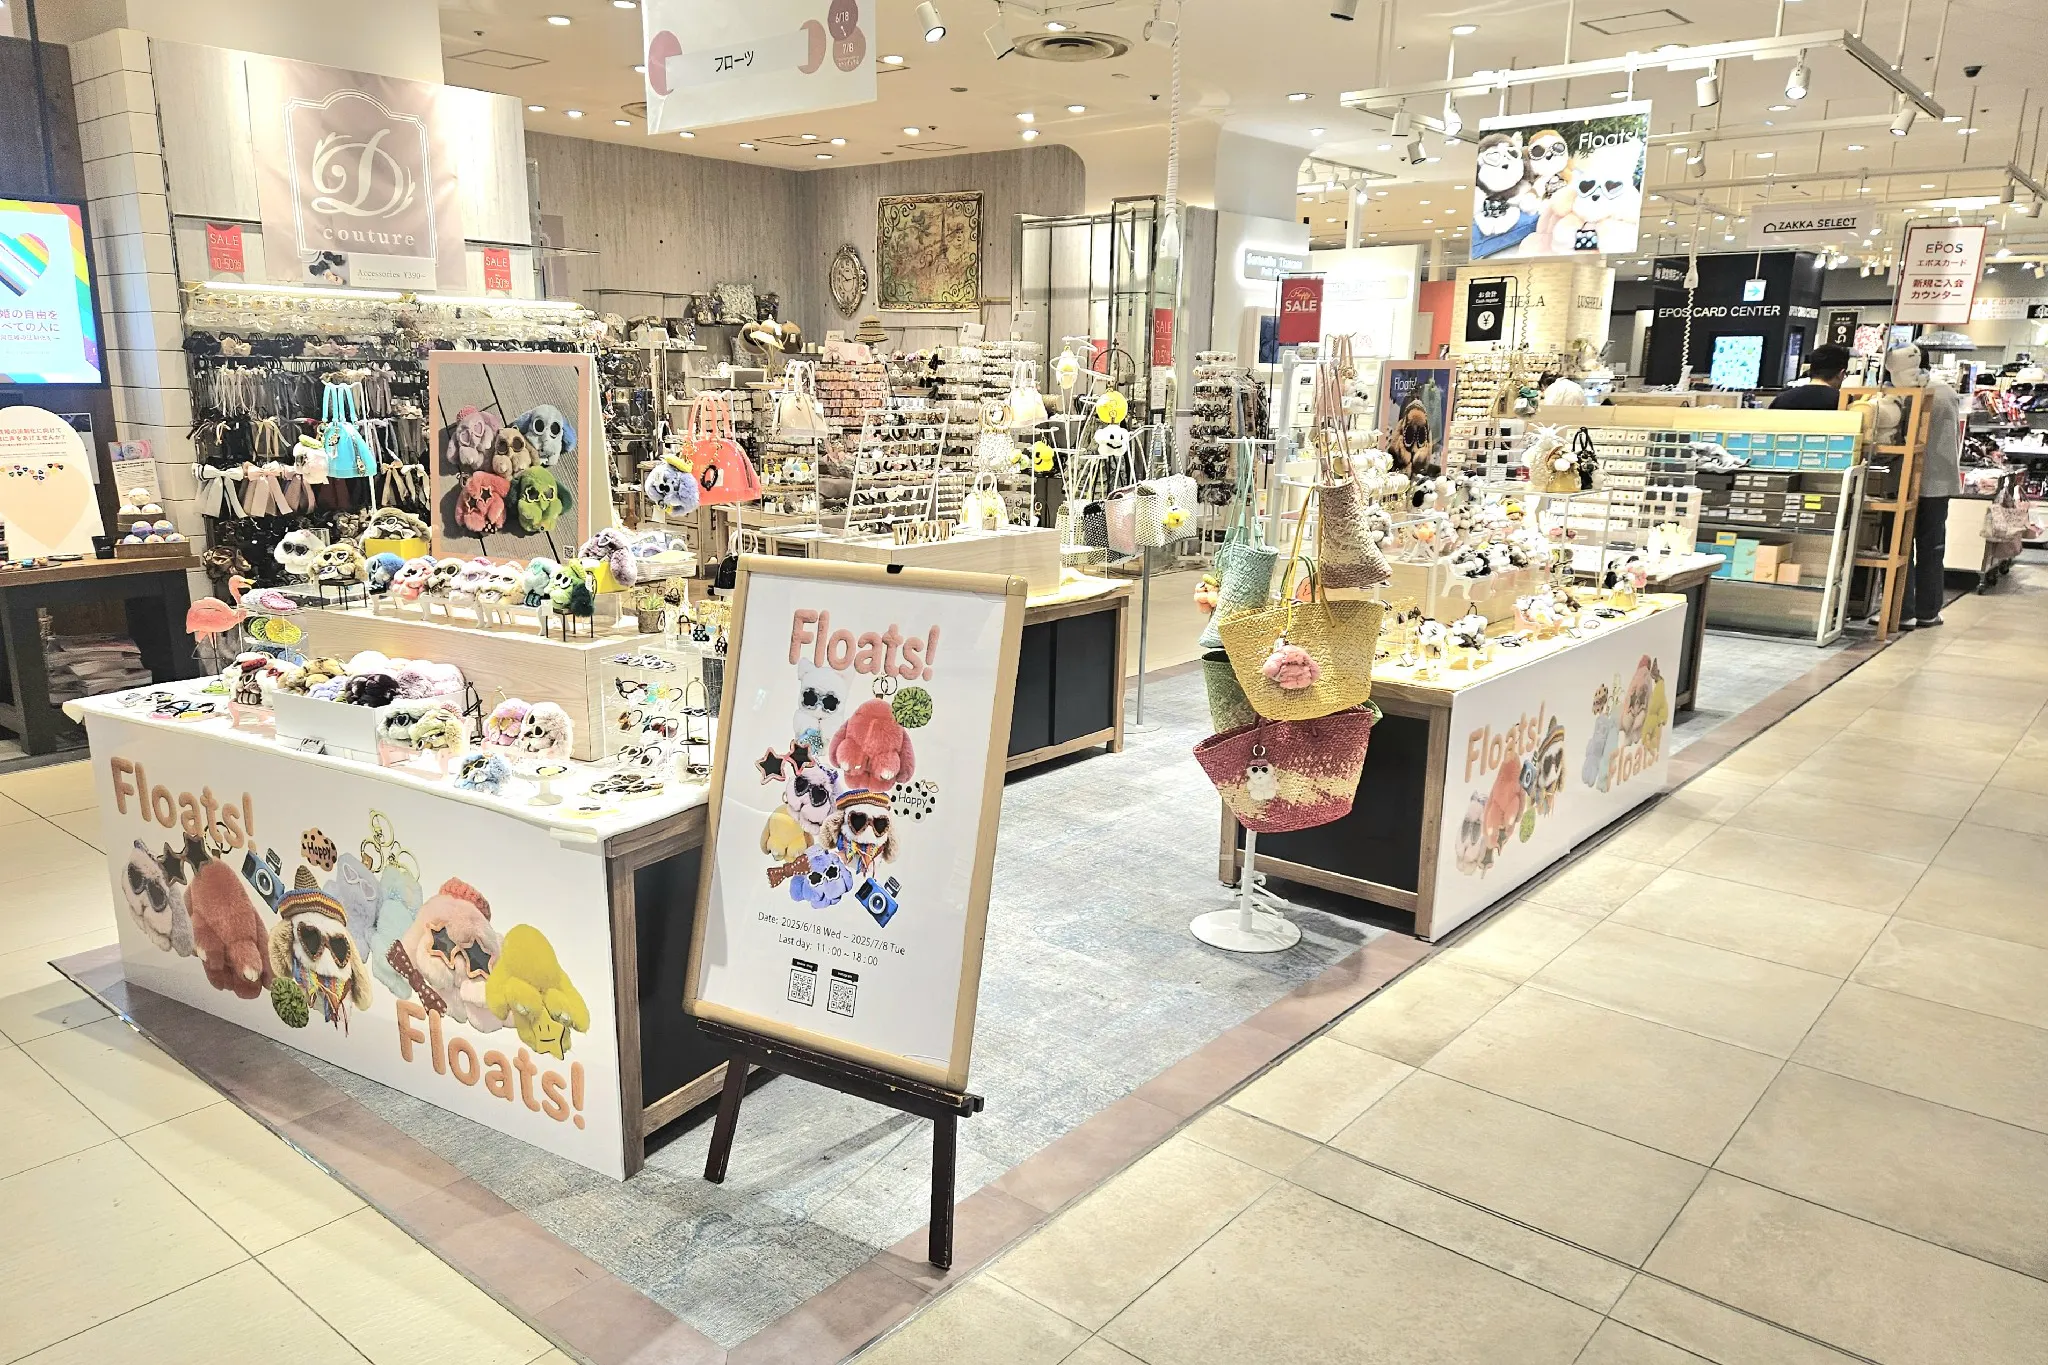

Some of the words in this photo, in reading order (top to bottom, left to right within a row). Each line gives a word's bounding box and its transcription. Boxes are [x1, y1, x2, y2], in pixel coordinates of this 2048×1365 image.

[835, 11, 850, 23] 6/18
[714, 50, 755, 73] フローツ
[1778, 219, 1814, 231] ZAKKA
[1817, 217, 1857, 229] SELECT
[210, 232, 240, 246] SALE
[323, 227, 416, 246] couture
[1925, 243, 1964, 254] EPOS
[485, 256, 509, 267] SALE
[1916, 259, 1968, 267] エポスカード
[1912, 278, 1964, 288] 新規ご入会
[1911, 290, 1962, 300] カウンター
[1285, 300, 1318, 312] SALE
[1659, 307, 1692, 318] EPOS
[1693, 306, 1727, 318] CARD
[1730, 305, 1781, 317] CENTER
[1155, 320, 1173, 334] SALE
[788, 608, 941, 682] Floats!
[1464, 700, 1546, 784] Floats!
[110, 755, 257, 855] Floats!
[898, 791, 928, 808] Happy
[758, 911, 779, 924] Date:
[781, 916, 821, 935] 2025/6/18
[823, 926, 842, 940] Wed
[851, 934, 888, 951] 2025/7/8
[890, 942, 906, 956] Tue
[778, 933, 795, 945] Last
[795, 938, 812, 951] day:
[395, 999, 586, 1131] Floats!
